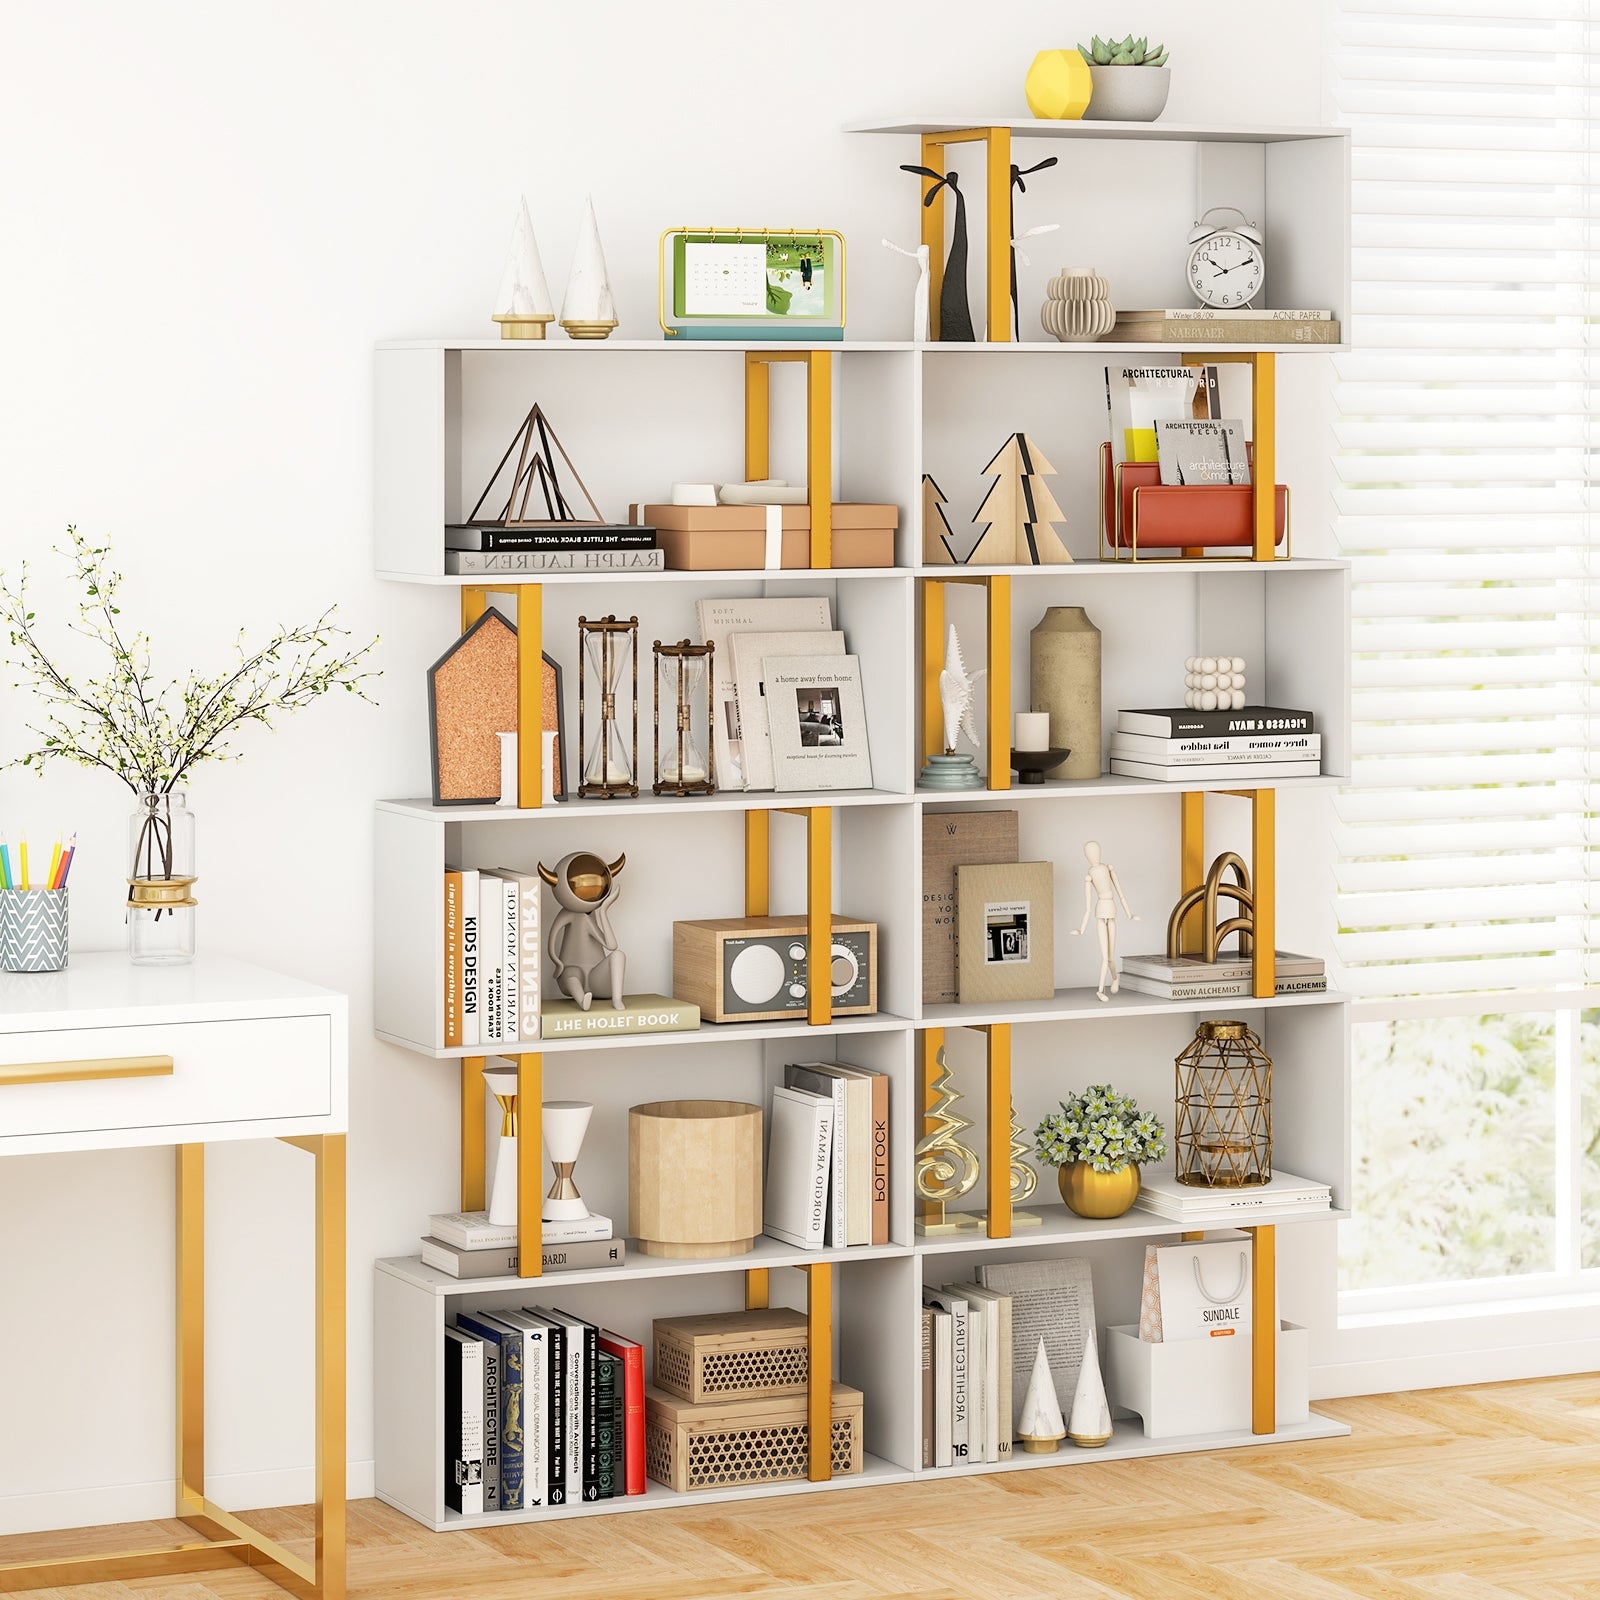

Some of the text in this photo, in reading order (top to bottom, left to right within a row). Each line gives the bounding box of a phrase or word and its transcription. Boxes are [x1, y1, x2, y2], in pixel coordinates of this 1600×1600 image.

[1207, 241, 1218, 251] 11
[1219, 237, 1231, 247] 12
[1236, 241, 1241, 250] 1
[1196, 252, 1208, 262] 10
[1247, 251, 1253, 260] 2
[1192, 265, 1198, 274] 9
[1253, 266, 1259, 275] 3
[1196, 280, 1202, 289] 8
[1247, 281, 1254, 290] 4
[1207, 290, 1213, 299] 7
[1222, 295, 1229, 304] 6
[1236, 291, 1242, 300] 5
[1172, 311, 1192, 320] Winter
[1273, 311, 1321, 320] ACNE PAPER
[1168, 327, 1225, 339] NAERVAER
[1122, 369, 1194, 379] ARCHITECTURAL
[1165, 422, 1217, 430] ARCHITECTURAL
[1189, 456, 1246, 471] architecture
[800, 676, 815, 684] away
[817, 674, 833, 682] from
[834, 674, 853, 682] home
[448, 883, 456, 930] simplicity
[449, 931, 456, 940] is
[449, 941, 456, 952] in
[465, 917, 477, 1014] KIDS DESIGN
[448, 953, 456, 1003] everything
[1286, 981, 1327, 990] ALCHEMIS
[1172, 986, 1241, 997] ROWN ALCHEMIST
[449, 1006, 455, 1018] we
[1203, 1307, 1240, 1322] SUNDALE
[487, 1356, 497, 1466] ARCHITECTURE
[488, 1486, 496, 1499] Z
